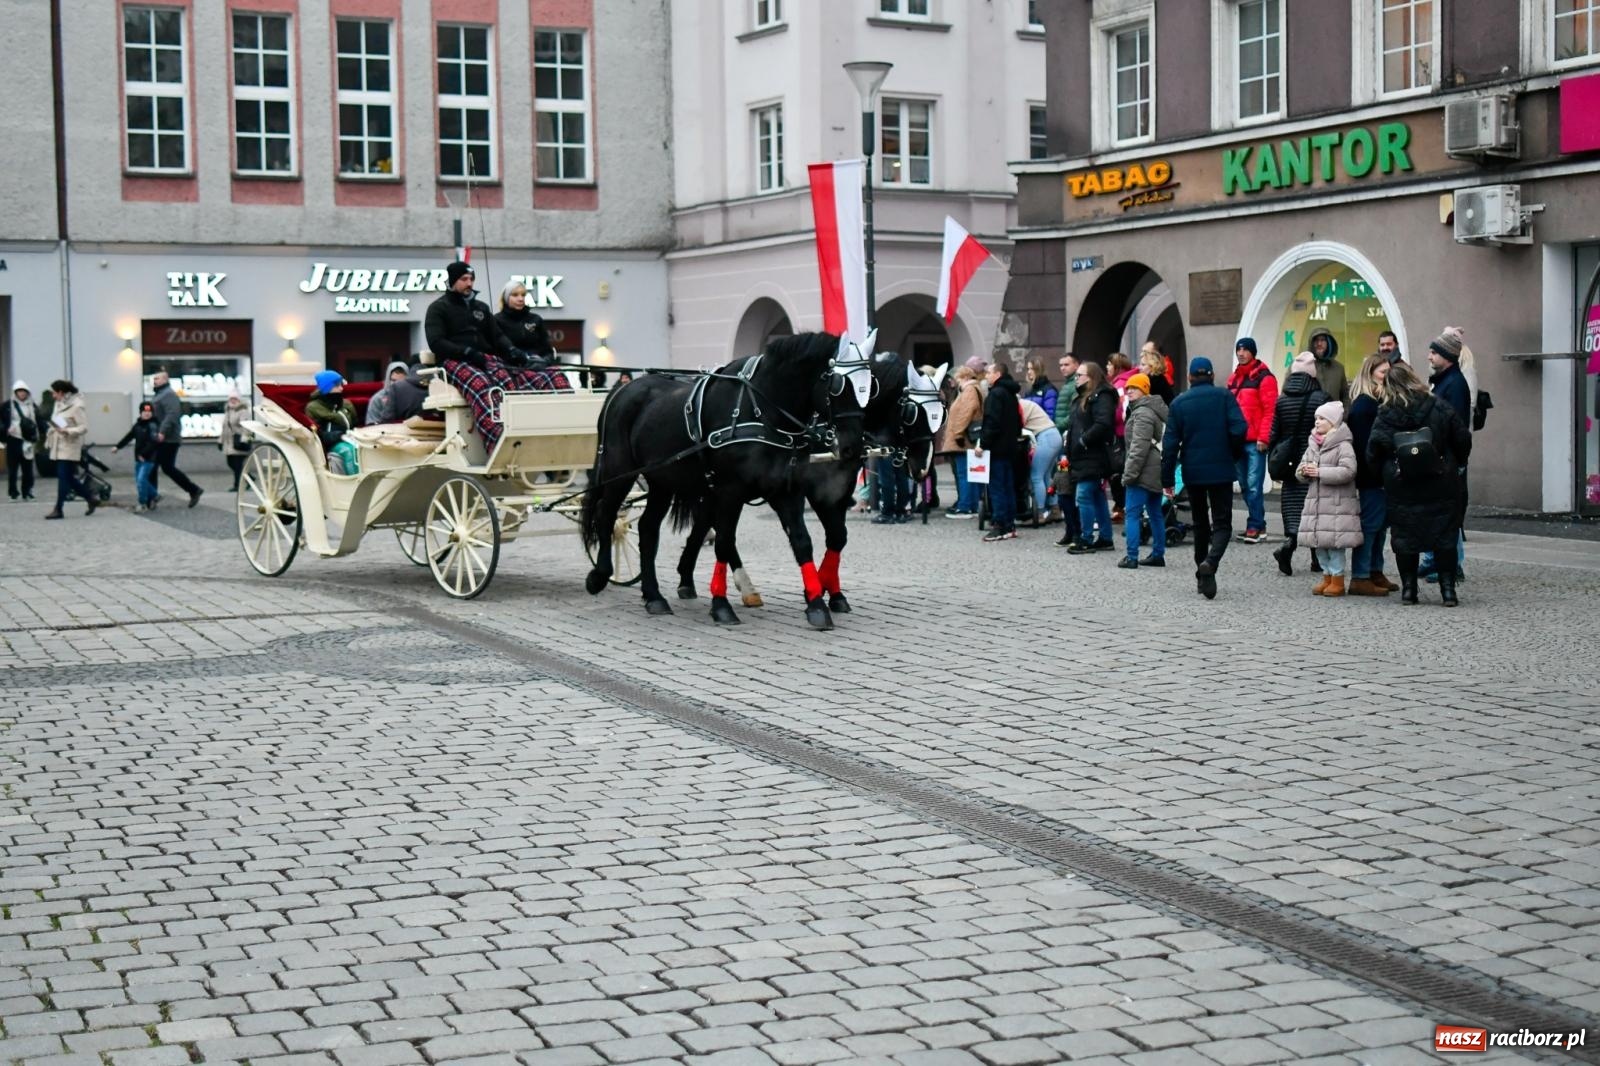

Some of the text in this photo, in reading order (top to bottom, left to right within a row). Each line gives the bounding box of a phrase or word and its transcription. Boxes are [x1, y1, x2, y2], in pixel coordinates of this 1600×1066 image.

[1222, 122, 1411, 194] KANTOR
[1067, 161, 1170, 197] TABAC
[299, 262, 449, 293] JUBILER
